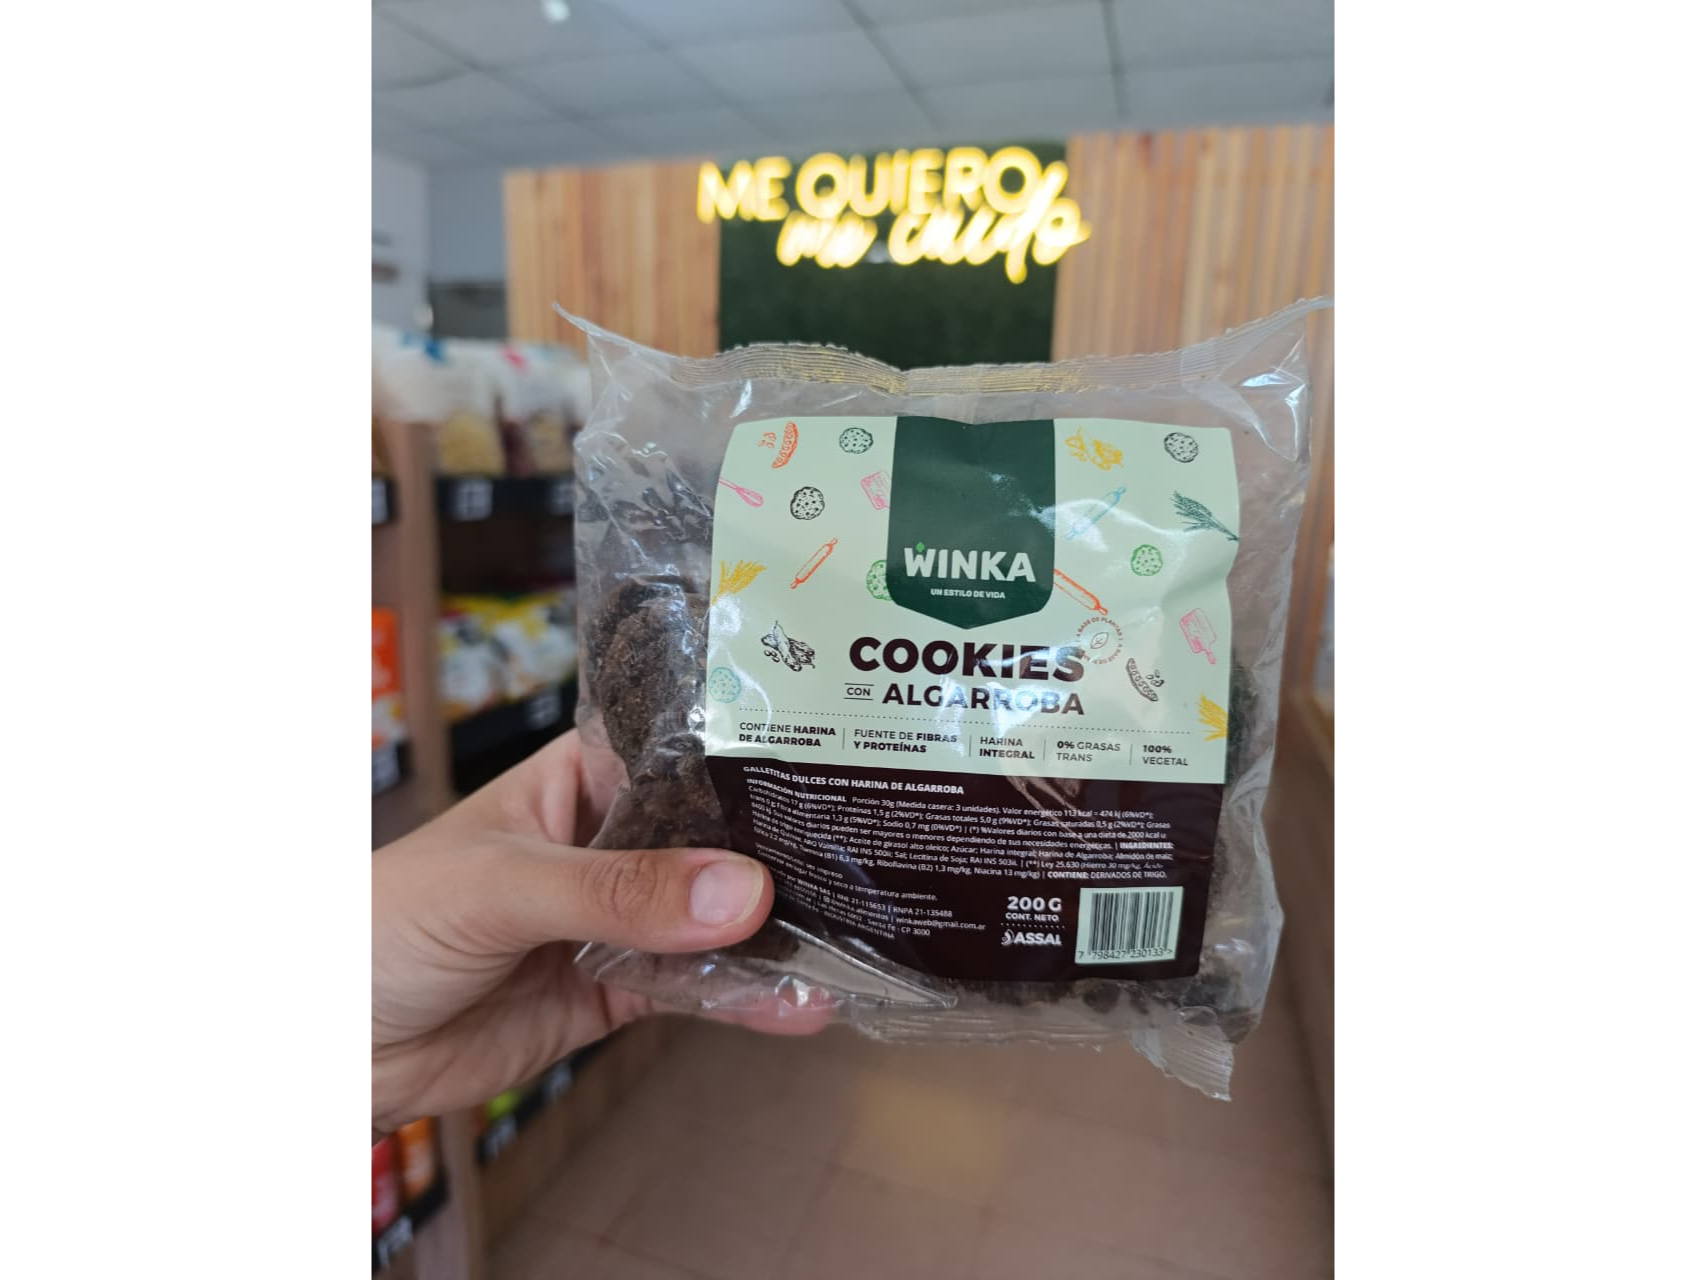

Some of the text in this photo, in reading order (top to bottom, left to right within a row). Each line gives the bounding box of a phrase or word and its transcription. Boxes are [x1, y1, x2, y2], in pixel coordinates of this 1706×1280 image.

[697, 146, 1041, 223] ME QUIERO
[903, 547, 1036, 583] WINKA
[930, 588, 1006, 599] UN ESTILO DE VIDA
[849, 636, 1084, 682] COOKIES
[846, 683, 1085, 716] CON ALGARROBA
[739, 722, 836, 736] CONTIENE HARINA
[739, 734, 822, 747] DE ALGARROBA
[854, 729, 958, 743] FUENTE DE FIBRAS
[980, 736, 1023, 748] HARINA
[853, 740, 927, 754] Y PROTEÍNAS
[1057, 740, 1121, 752] 0% GRASAS
[1143, 744, 1172, 754] 100%
[979, 748, 1035, 760] INTEGRAL
[1056, 752, 1093, 762] TRANS
[1142, 756, 1189, 766] VEGETAL
[743, 766, 964, 795] GALLETITAS DULCES CON HARINA DE ALGARROBA
[1002, 807, 1021, 815] Valor
[872, 829, 905, 839] mayores
[912, 833, 946, 842] menores
[1007, 896, 1062, 912] 200 G
[1005, 912, 1060, 922] CONT. NETO
[1013, 931, 1062, 947] ASSAL
[1077, 951, 1084, 960] 7
